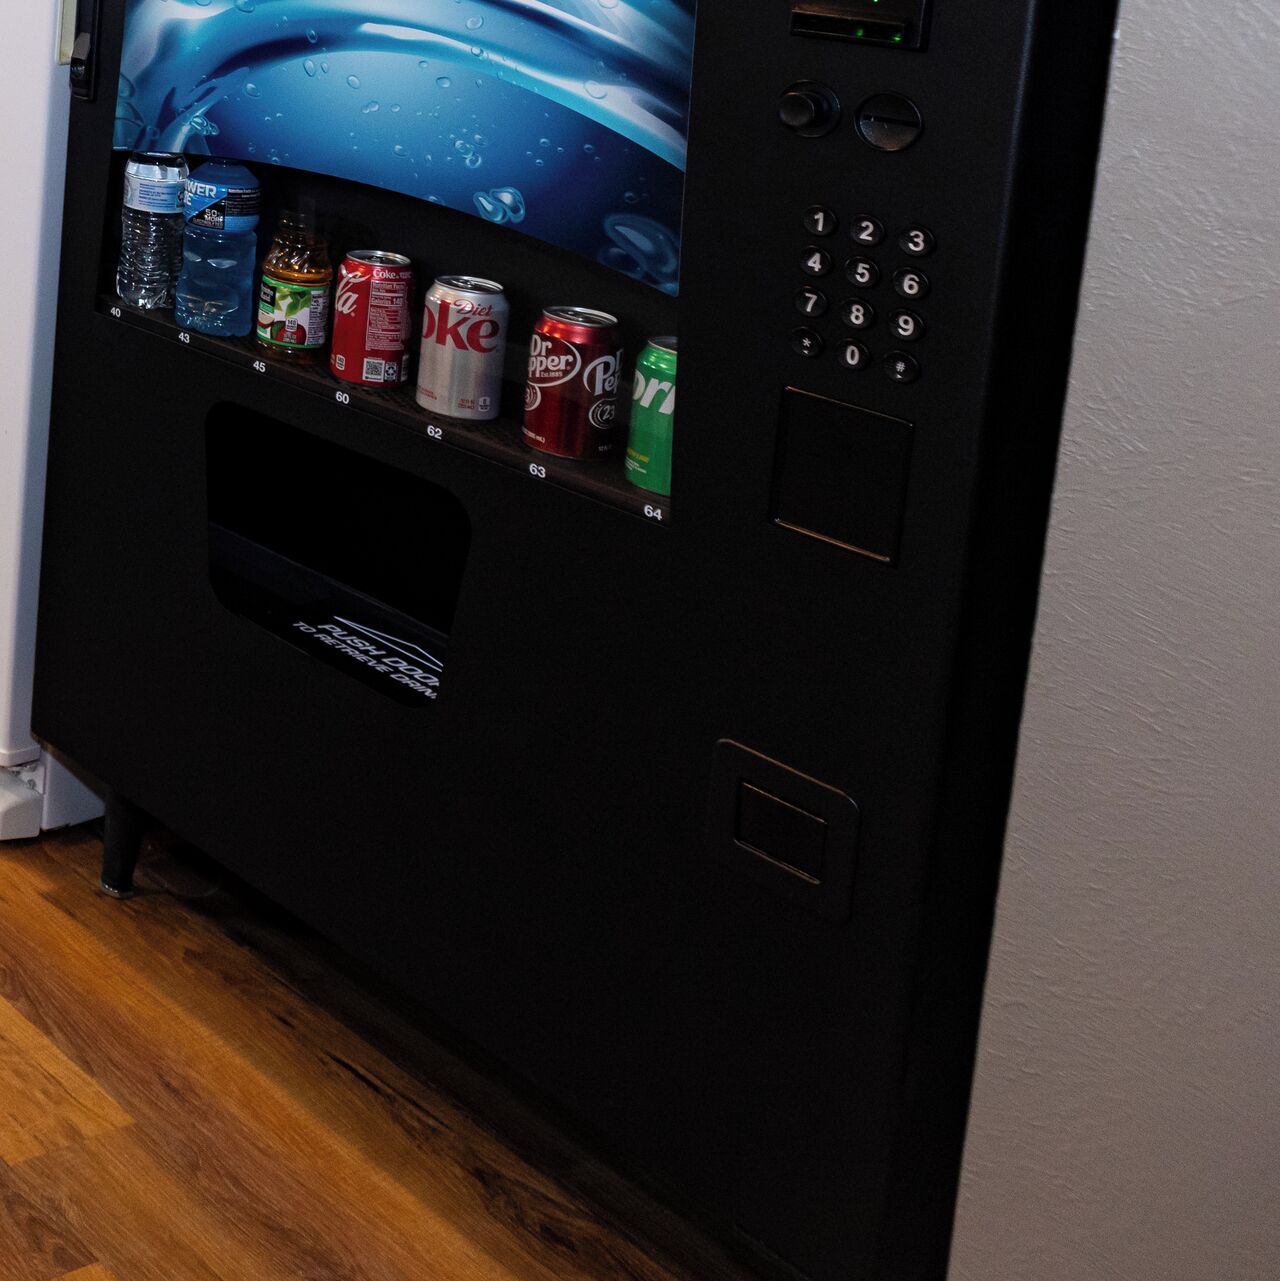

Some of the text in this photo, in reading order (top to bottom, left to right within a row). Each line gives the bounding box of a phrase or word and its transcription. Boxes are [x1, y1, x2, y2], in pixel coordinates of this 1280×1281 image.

[813, 212, 925, 252] 1 2 3
[807, 252, 920, 295] 4 5 6
[109, 307, 121, 318] 40
[454, 299, 493, 316] Diet
[804, 292, 915, 336] 7 8 9
[178, 332, 190, 344] 43
[530, 334, 552, 356] Dr
[845, 345, 860, 365] 0
[252, 360, 267, 373] 45
[527, 355, 574, 378] pper
[335, 391, 350, 404] 60
[427, 425, 442, 439] 62
[529, 463, 546, 478] 63
[644, 505, 662, 520] 64
[317, 624, 387, 656] PUSH
[292, 621, 437, 700] TO RETRIEVE DRIN
